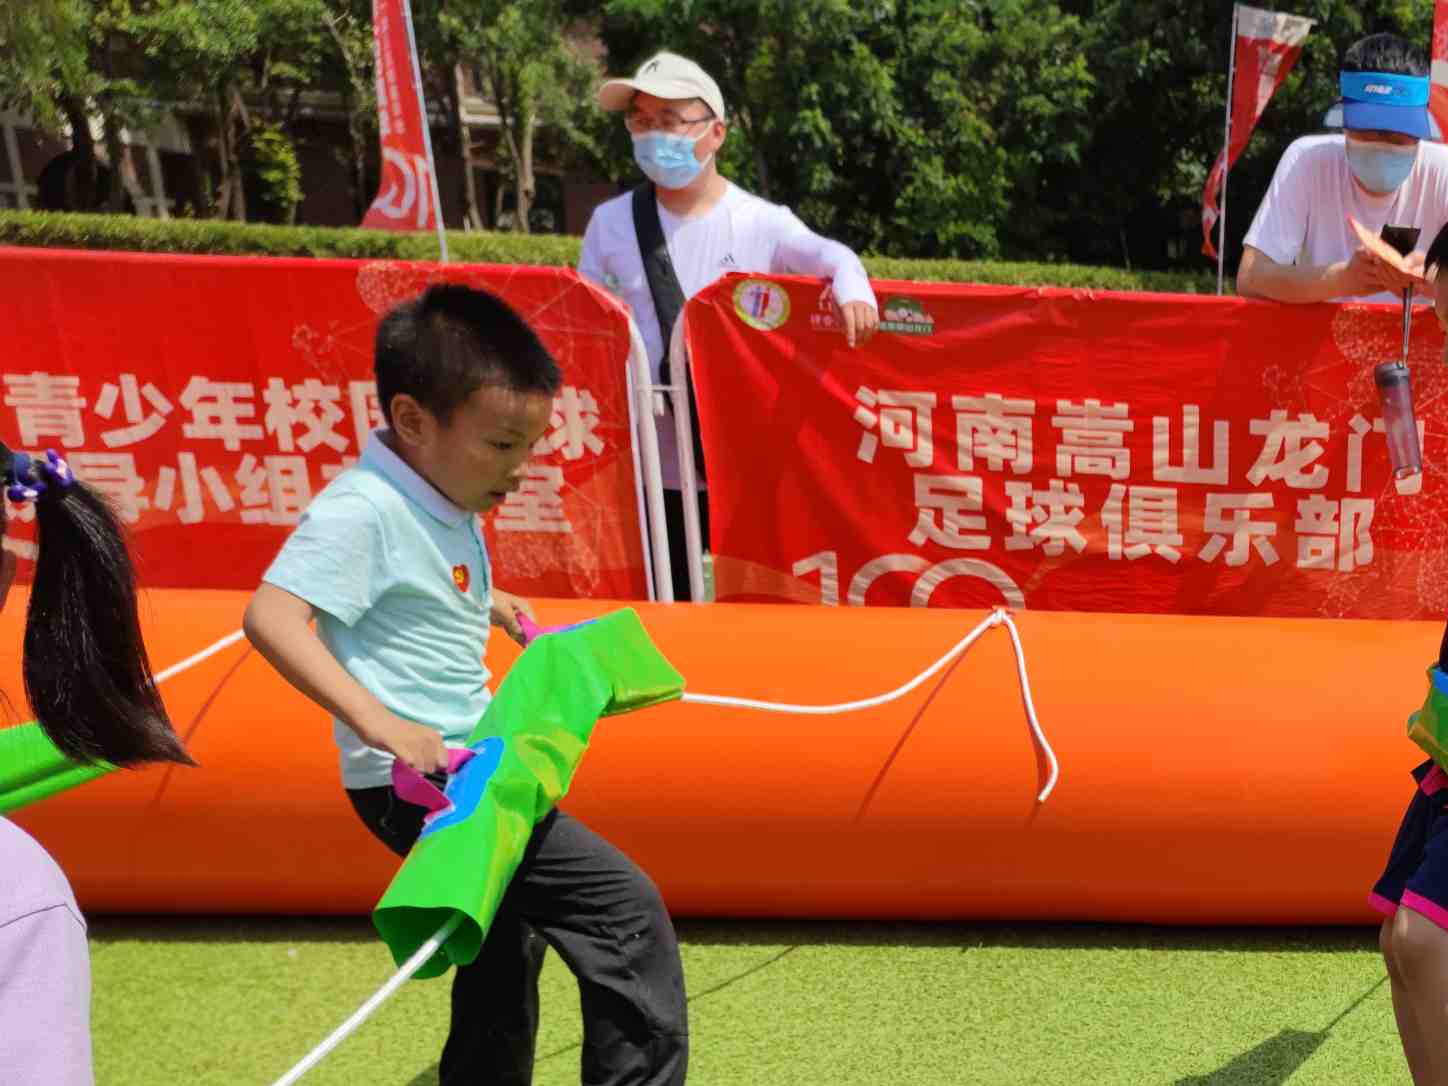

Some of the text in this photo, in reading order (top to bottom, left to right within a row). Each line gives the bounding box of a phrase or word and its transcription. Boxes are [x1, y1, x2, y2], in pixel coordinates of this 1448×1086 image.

[3, 371, 605, 460] 青少年校球
[853, 385, 1425, 496] 河南嵩山龙门
[907, 473, 1376, 573] 足球俱乐部
